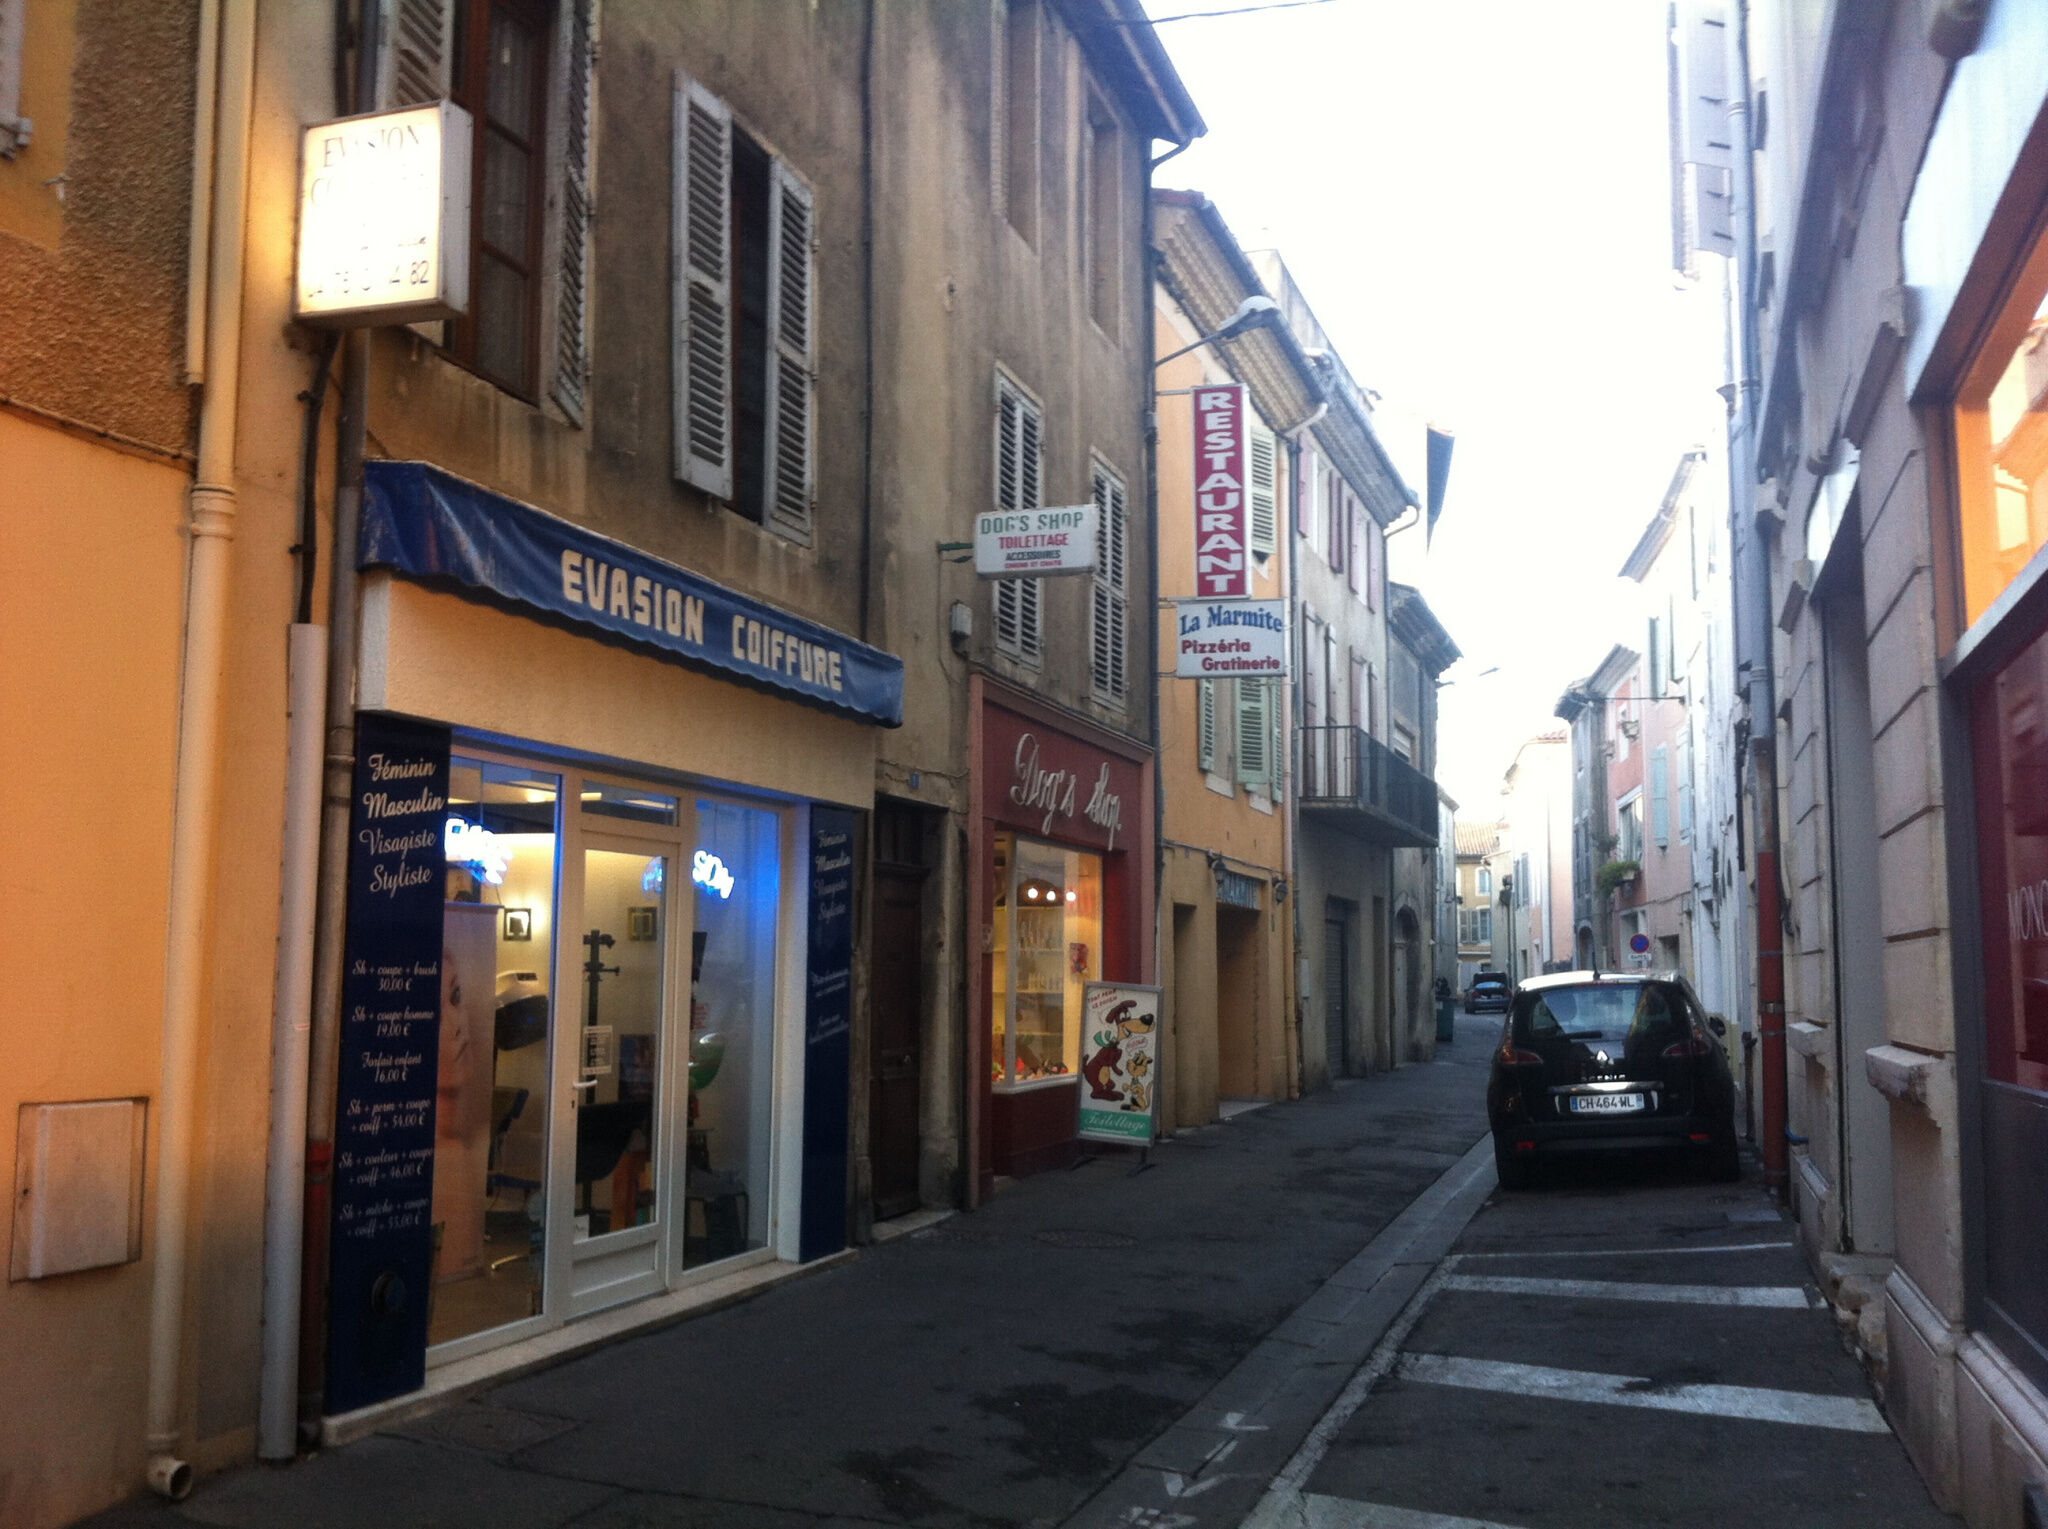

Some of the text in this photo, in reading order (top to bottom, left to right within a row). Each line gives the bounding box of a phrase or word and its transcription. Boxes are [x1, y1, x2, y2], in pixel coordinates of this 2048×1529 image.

[1197, 391, 1244, 593] RESTAURANT
[981, 511, 1083, 535] DOG'S SHOP
[999, 533, 1069, 549] TOILETTAGE
[1005, 550, 1061, 561] ACCESSOIRES
[561, 549, 843, 692] EVASION COIFFURE
[1180, 605, 1284, 636] La Marmite
[1182, 638, 1252, 654] Pizzéria
[1202, 655, 1281, 671] Gratinerie
[368, 754, 437, 781] Féminin
[363, 786, 445, 819] Masculin
[359, 828, 438, 860] Visagiste
[370, 861, 432, 899] Styliste
[377, 966, 402, 978] coupe
[414, 960, 437, 976] brush
